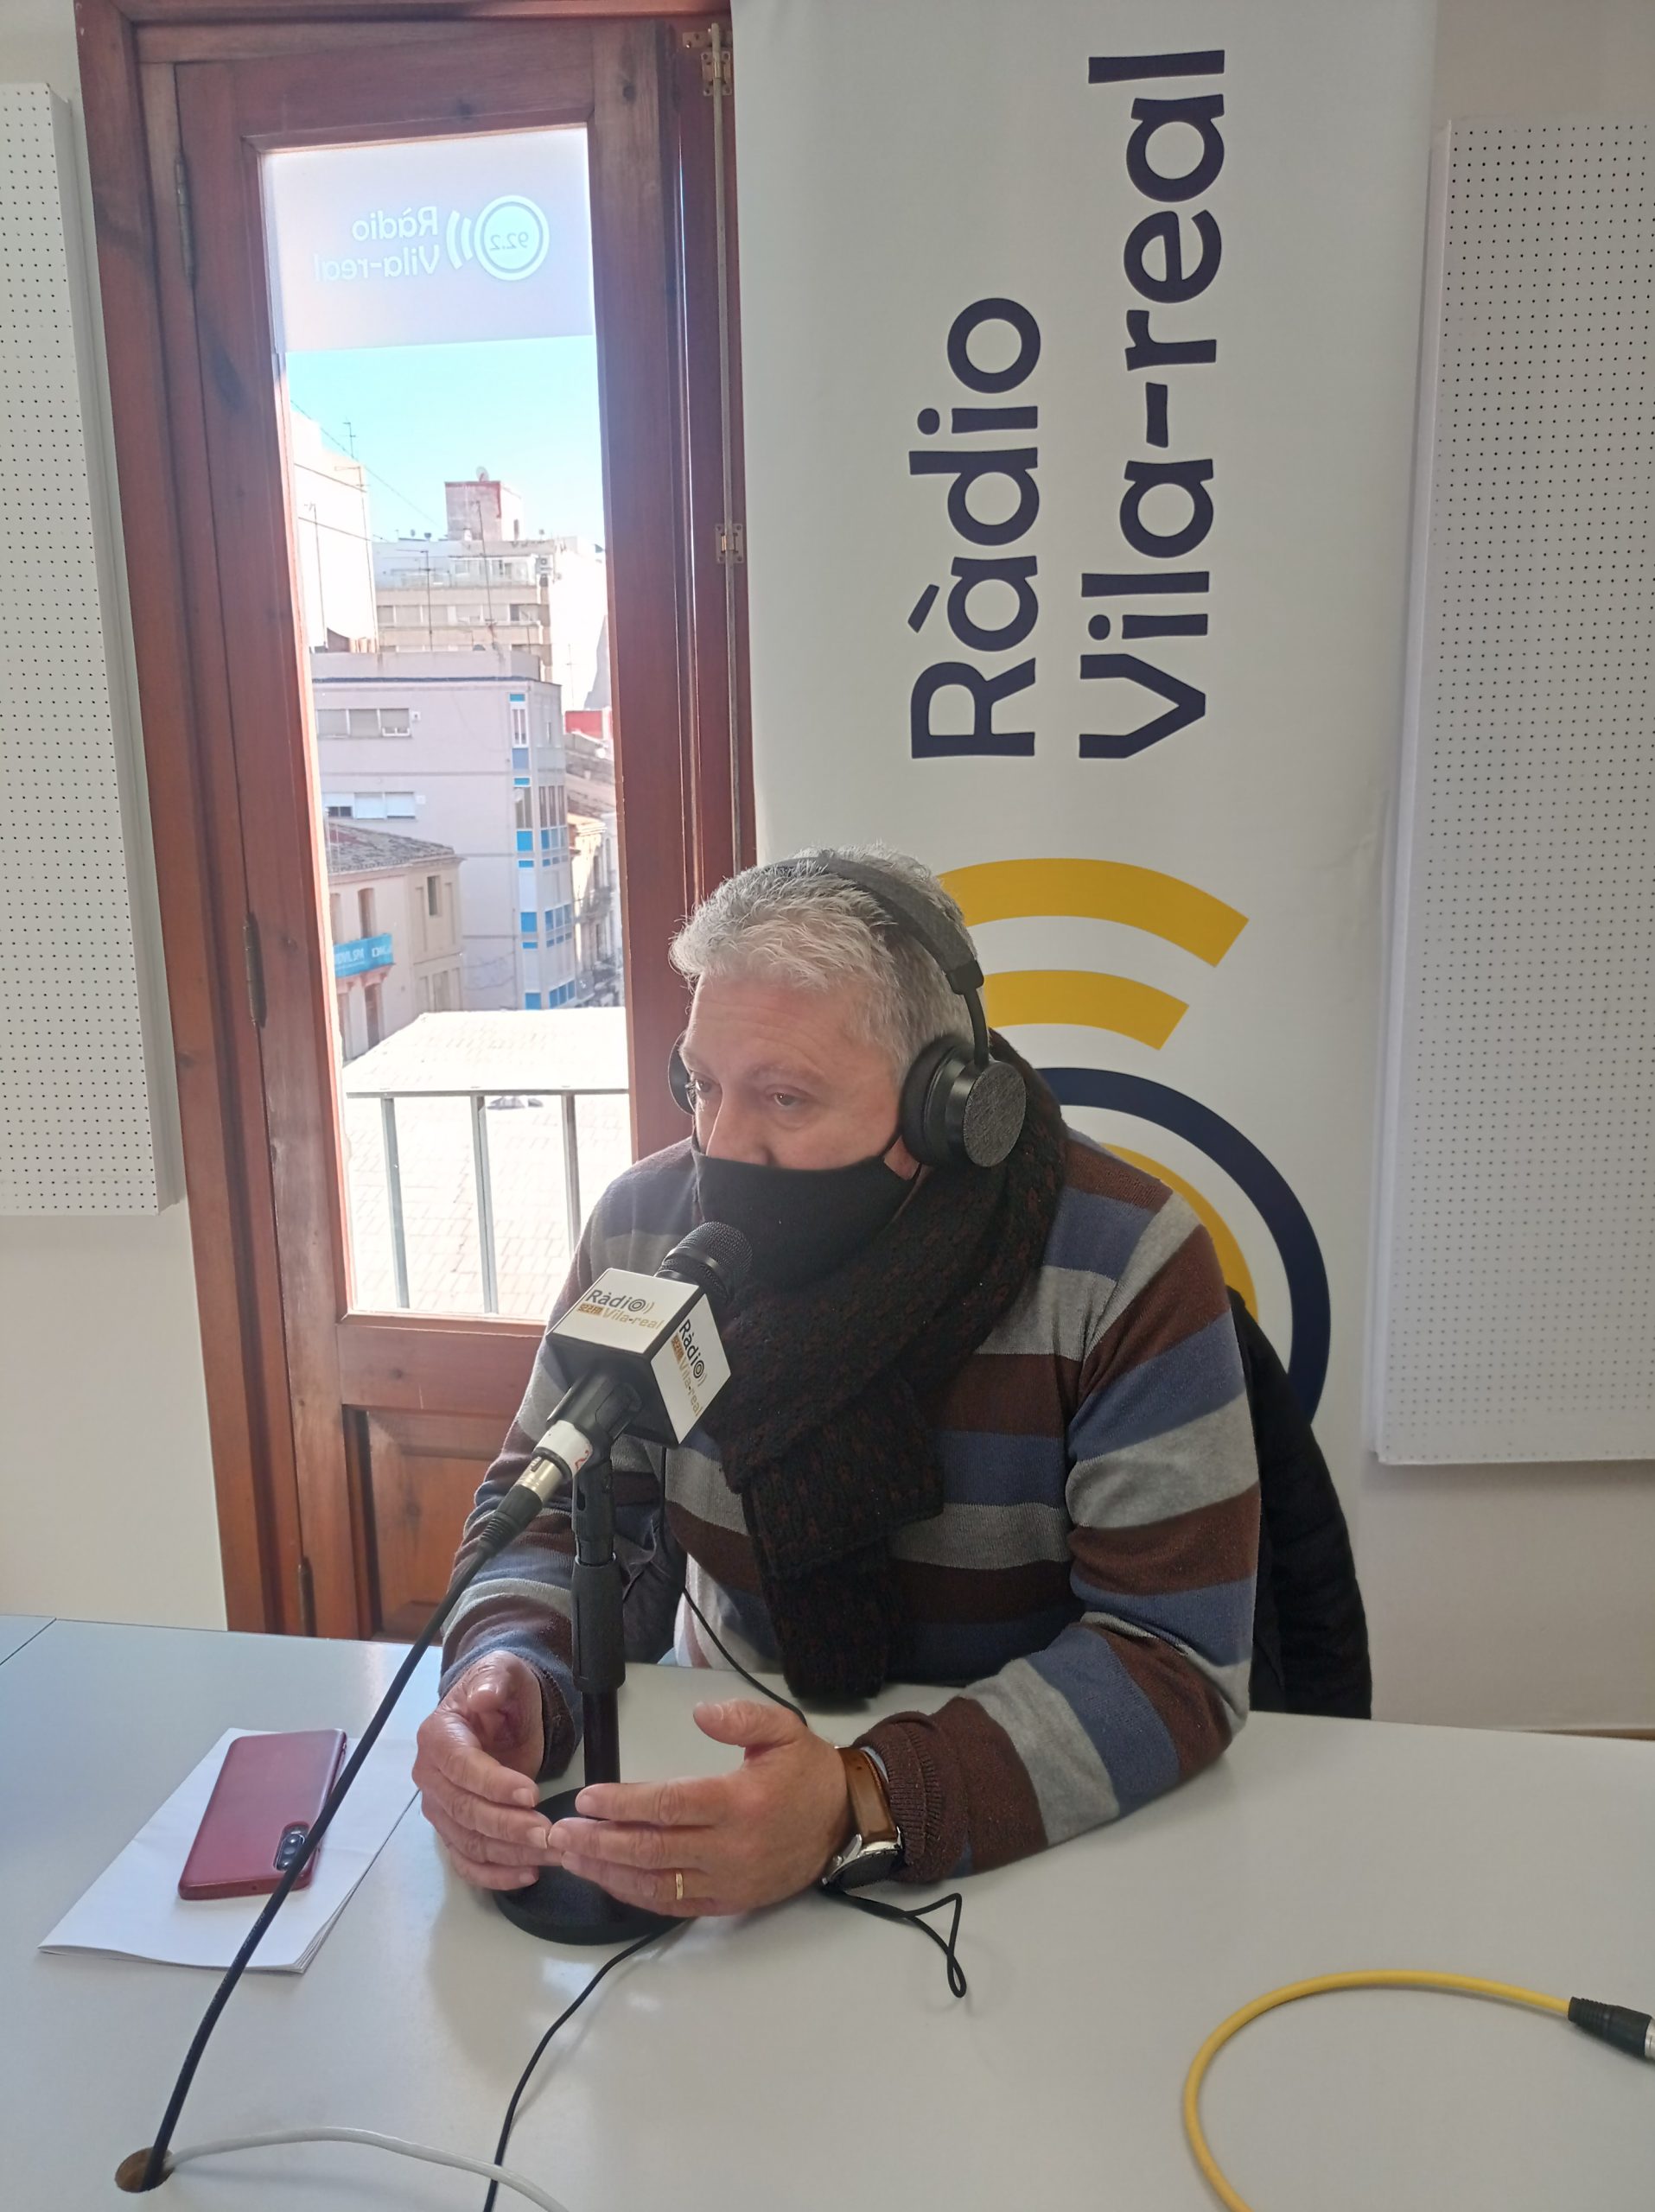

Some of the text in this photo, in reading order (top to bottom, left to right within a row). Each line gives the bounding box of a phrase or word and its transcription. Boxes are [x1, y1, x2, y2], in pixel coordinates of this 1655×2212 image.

[907, 297, 1041, 760] Ràdio
[1079, 49, 1225, 760] Vila-real
[602, 1307, 665, 1329] Vila-real
[679, 1356, 703, 1417] Vila-real
